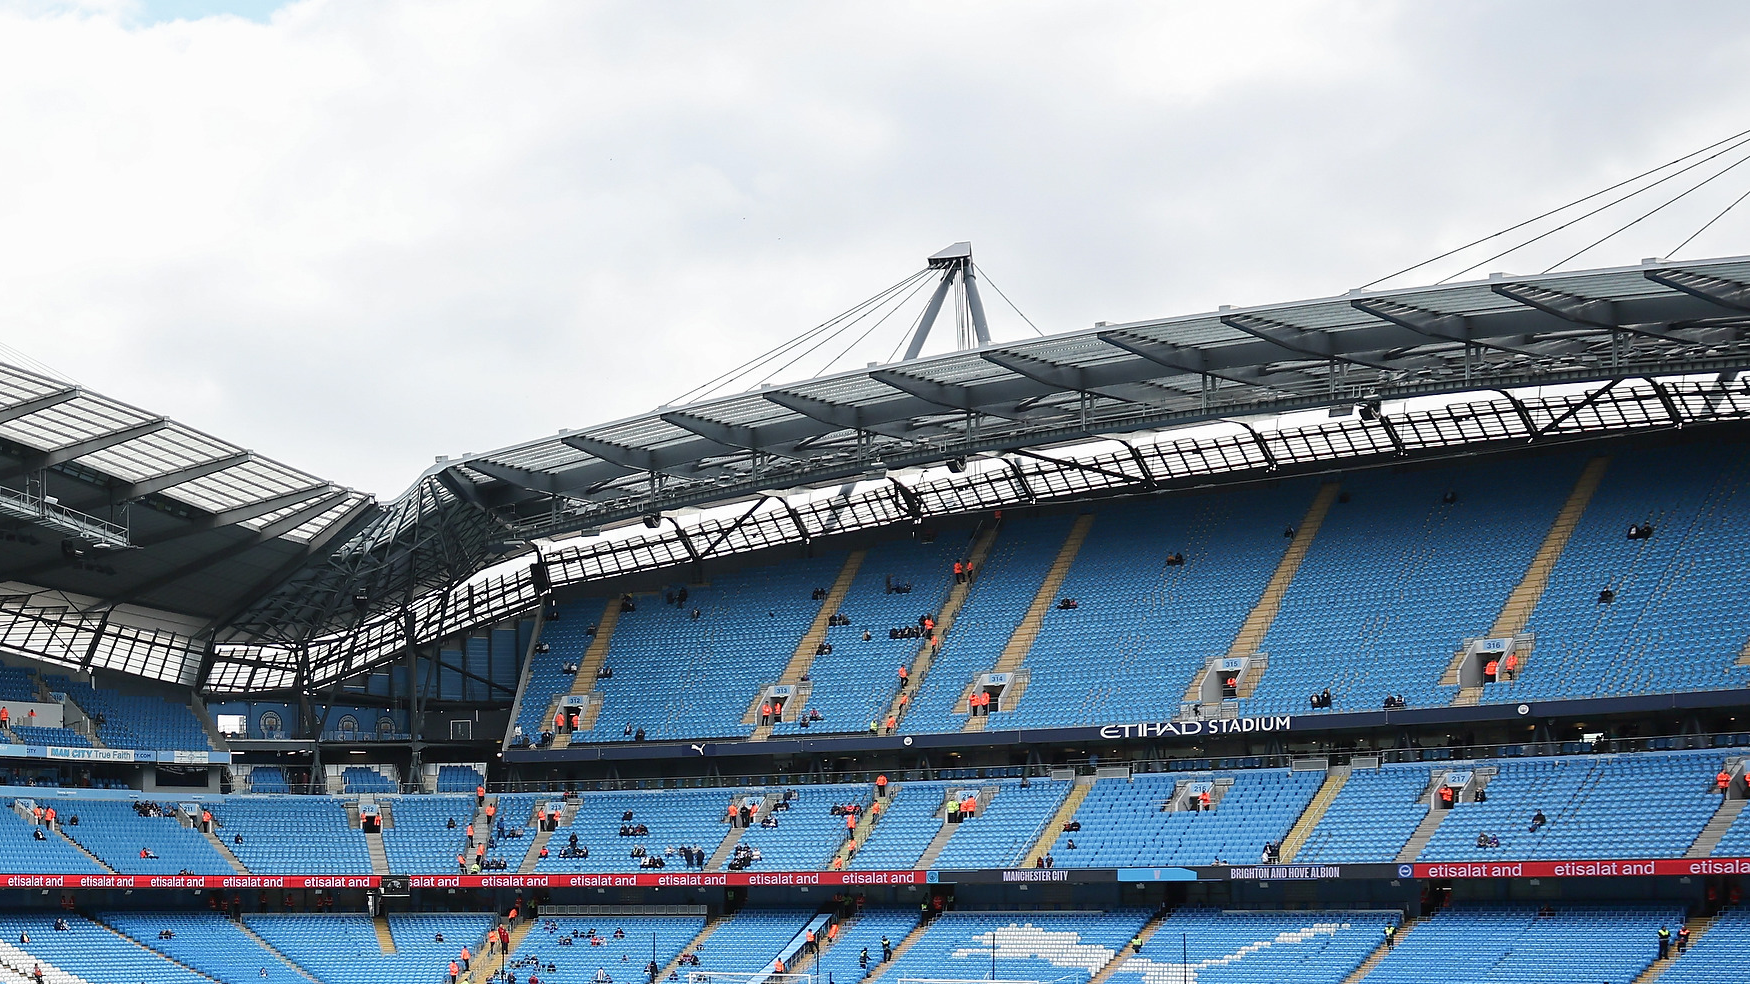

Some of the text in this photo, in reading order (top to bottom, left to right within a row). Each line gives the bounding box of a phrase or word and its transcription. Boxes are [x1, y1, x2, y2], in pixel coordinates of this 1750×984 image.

[1100, 715, 1291, 739] ETIHAD STADIUM
[51, 748, 131, 760] MAN CITY True Faith
[1230, 866, 1340, 880] BRIGHTON AND HOVE ALBION
[1428, 862, 1522, 877] etisalat and
[1554, 860, 1655, 876] etisalat and
[8, 875, 63, 887] etisalat and
[81, 875, 135, 887] etisalat and
[151, 876, 204, 888] etisalat and
[223, 876, 283, 888] etisalat and
[305, 876, 369, 888] etisalat and
[408, 876, 459, 887] salat and
[482, 875, 548, 887] etisalat and
[570, 875, 636, 887] etisalat and
[659, 874, 726, 886] etisalat and
[749, 873, 818, 885] etisalat and
[843, 871, 914, 883] etisalat and
[1003, 870, 1069, 882] MANCHESTER CITY
